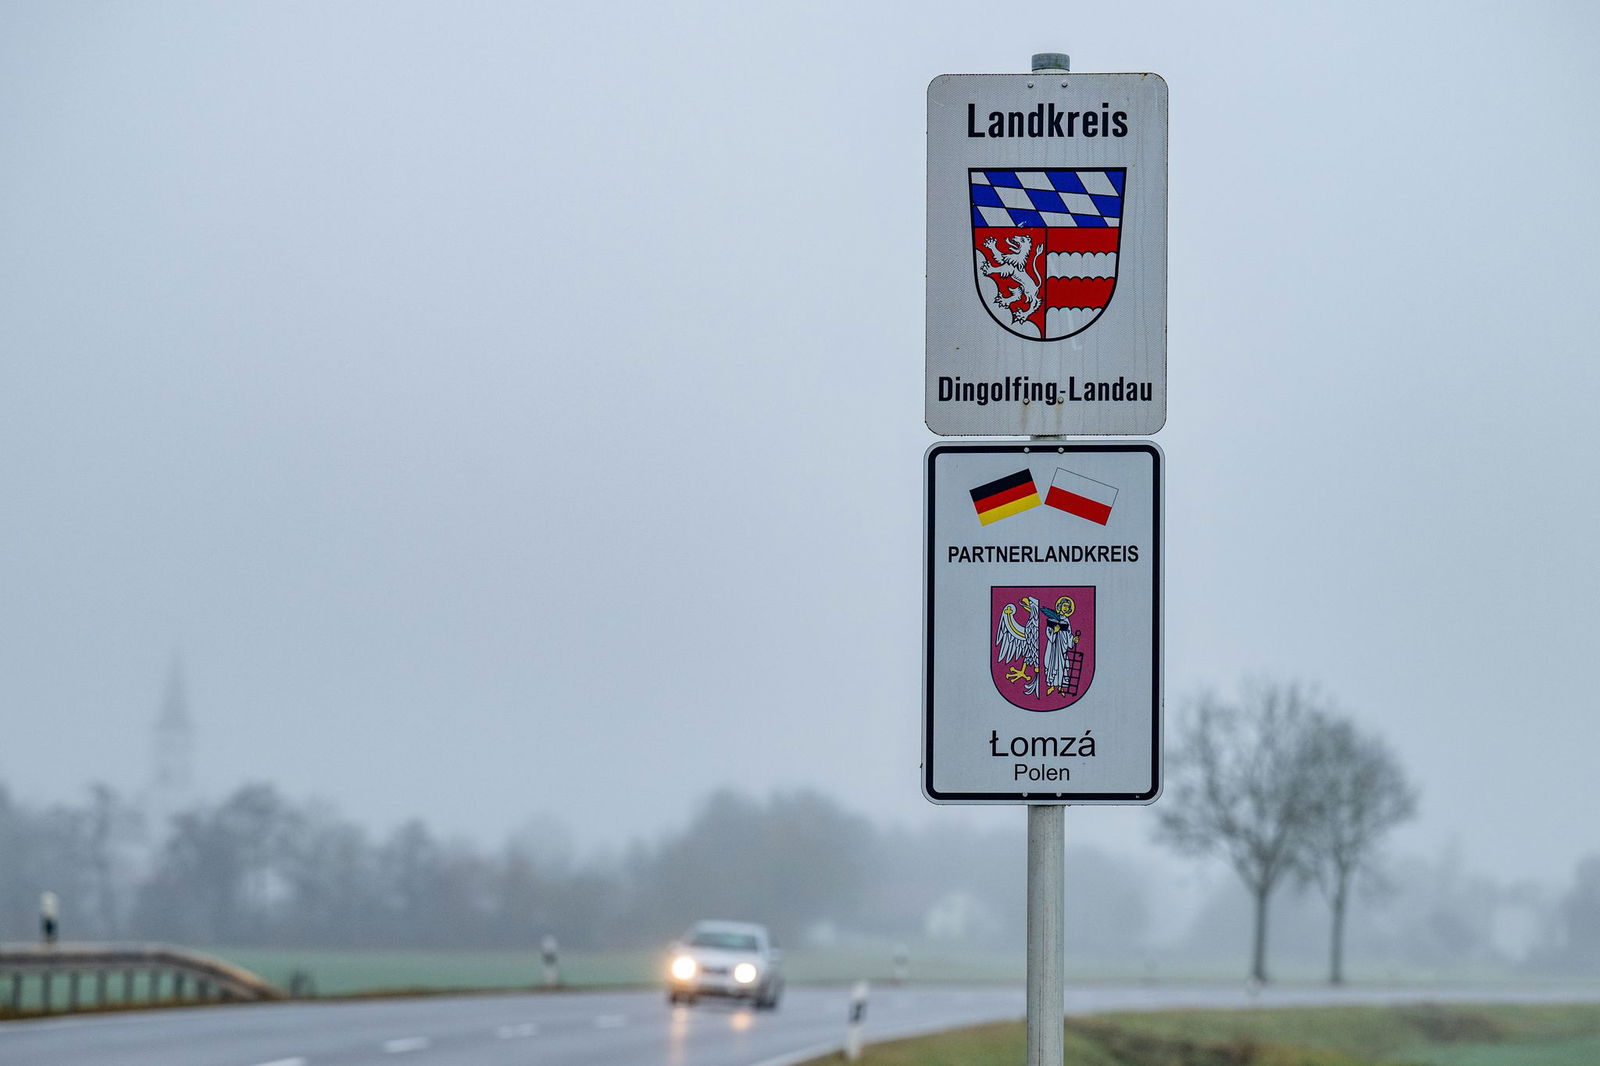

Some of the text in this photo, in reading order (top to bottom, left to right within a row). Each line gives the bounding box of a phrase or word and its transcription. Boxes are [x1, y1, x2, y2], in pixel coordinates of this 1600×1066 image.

[968, 103, 1128, 138] Landkreis
[938, 376, 1152, 406] Dingolfing-Landau
[949, 545, 1139, 564] PARTNERLANDKREIS
[989, 730, 1096, 757] Łomzá
[1014, 764, 1070, 781] Polen
